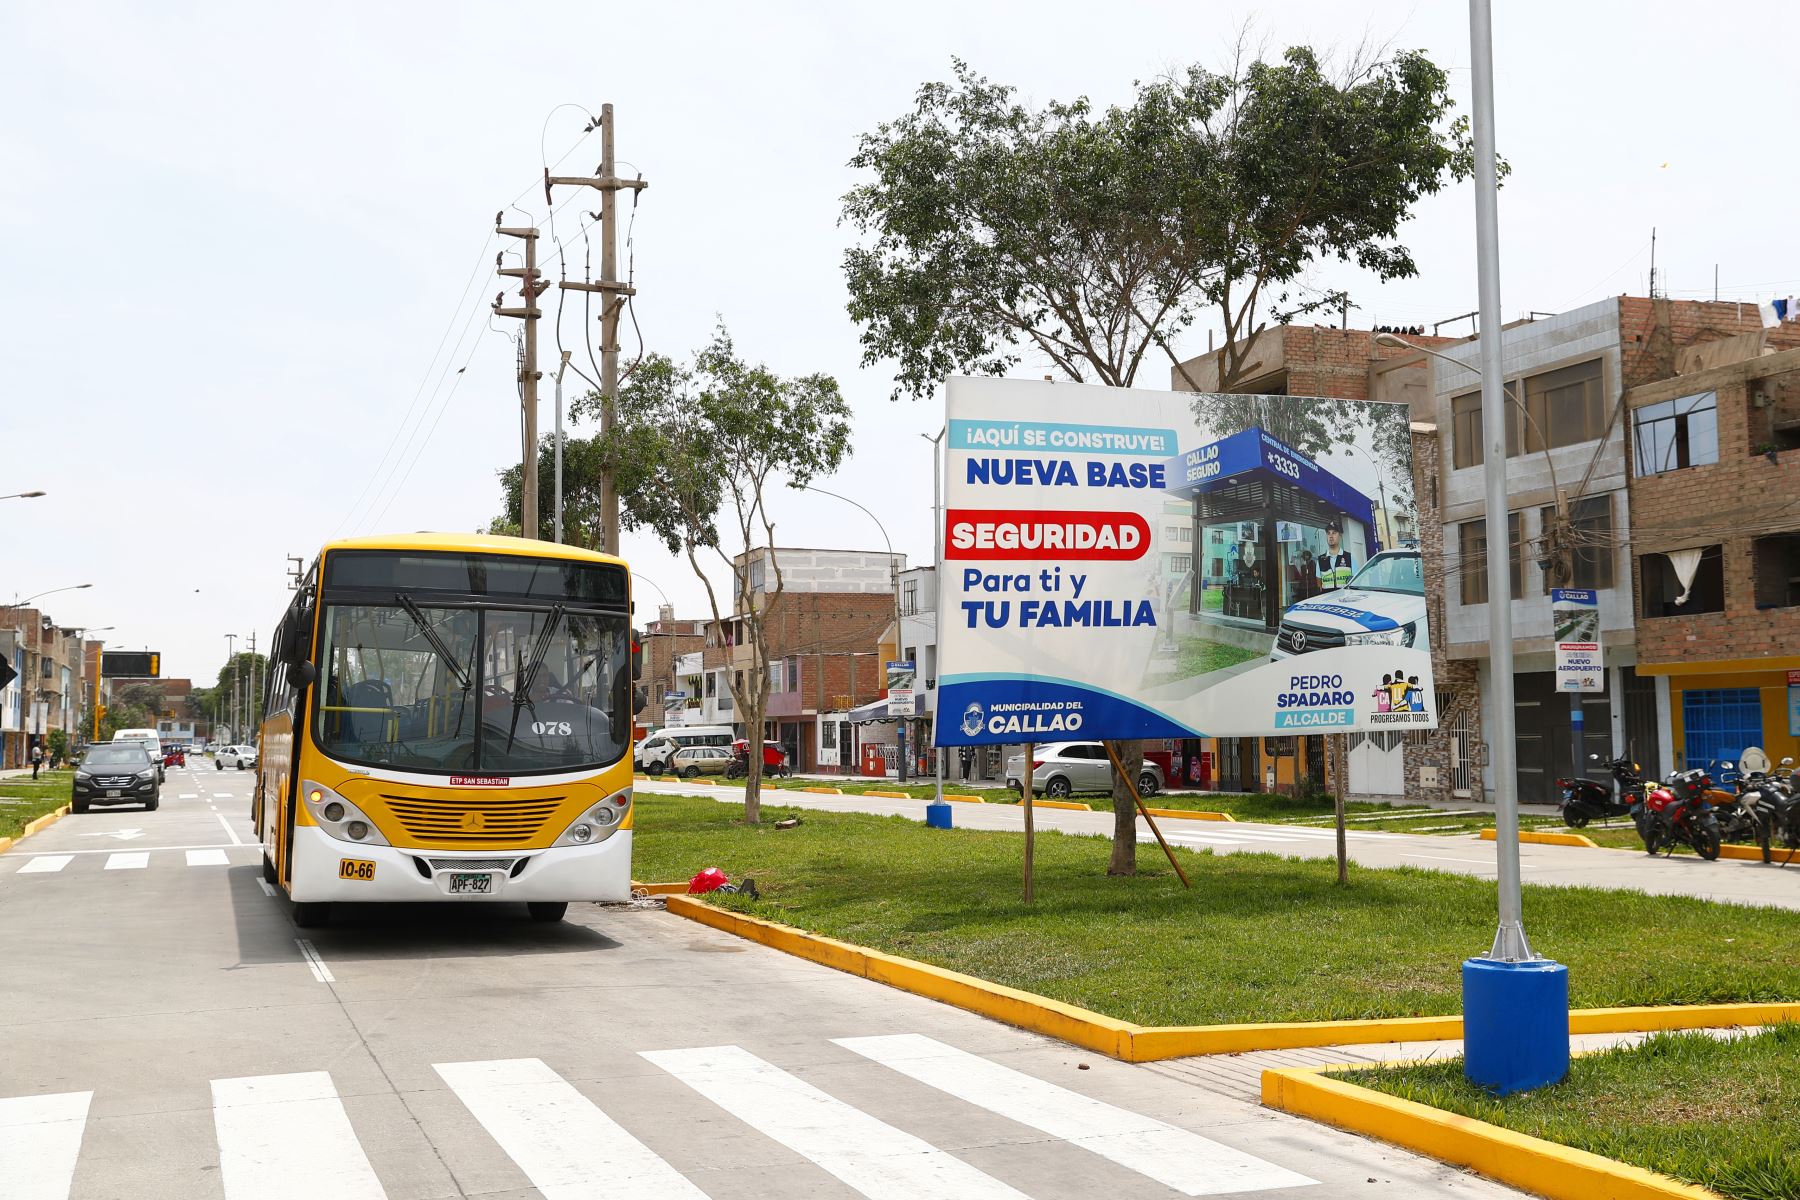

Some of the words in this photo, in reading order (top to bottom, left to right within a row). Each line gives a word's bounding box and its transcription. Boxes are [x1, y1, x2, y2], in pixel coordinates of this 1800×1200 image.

[967, 425, 1019, 448] ¡AQUÍ
[1023, 430, 1046, 447] SE
[1049, 431, 1165, 451] CONSTRUYE!
[1186, 445, 1219, 466] CALLAO
[966, 458, 1078, 487] NUEVA
[1086, 461, 1166, 488] BASE
[1186, 461, 1220, 481] SEGURO
[951, 522, 1140, 550] SEGURIDAD
[963, 568, 1031, 593] Para
[1039, 566, 1061, 592] ti
[1069, 574, 1087, 599] y
[961, 601, 1010, 629] TU
[1019, 600, 1157, 628] FAMILIA
[1290, 674, 1343, 690] PEDRO
[990, 702, 1064, 712] MUNICIPALIDAD
[1066, 701, 1083, 710] DEL
[1277, 691, 1355, 708] SPADARO
[1379, 692, 1390, 704] CA
[1411, 691, 1422, 704] AO
[988, 713, 1083, 734] CALLAO
[1283, 712, 1346, 726] ALCALDE
[1370, 714, 1411, 723] PROGRESAMOS
[1412, 713, 1430, 723] TODOS
[531, 721, 572, 736] 078
[451, 878, 490, 890] APF-827
